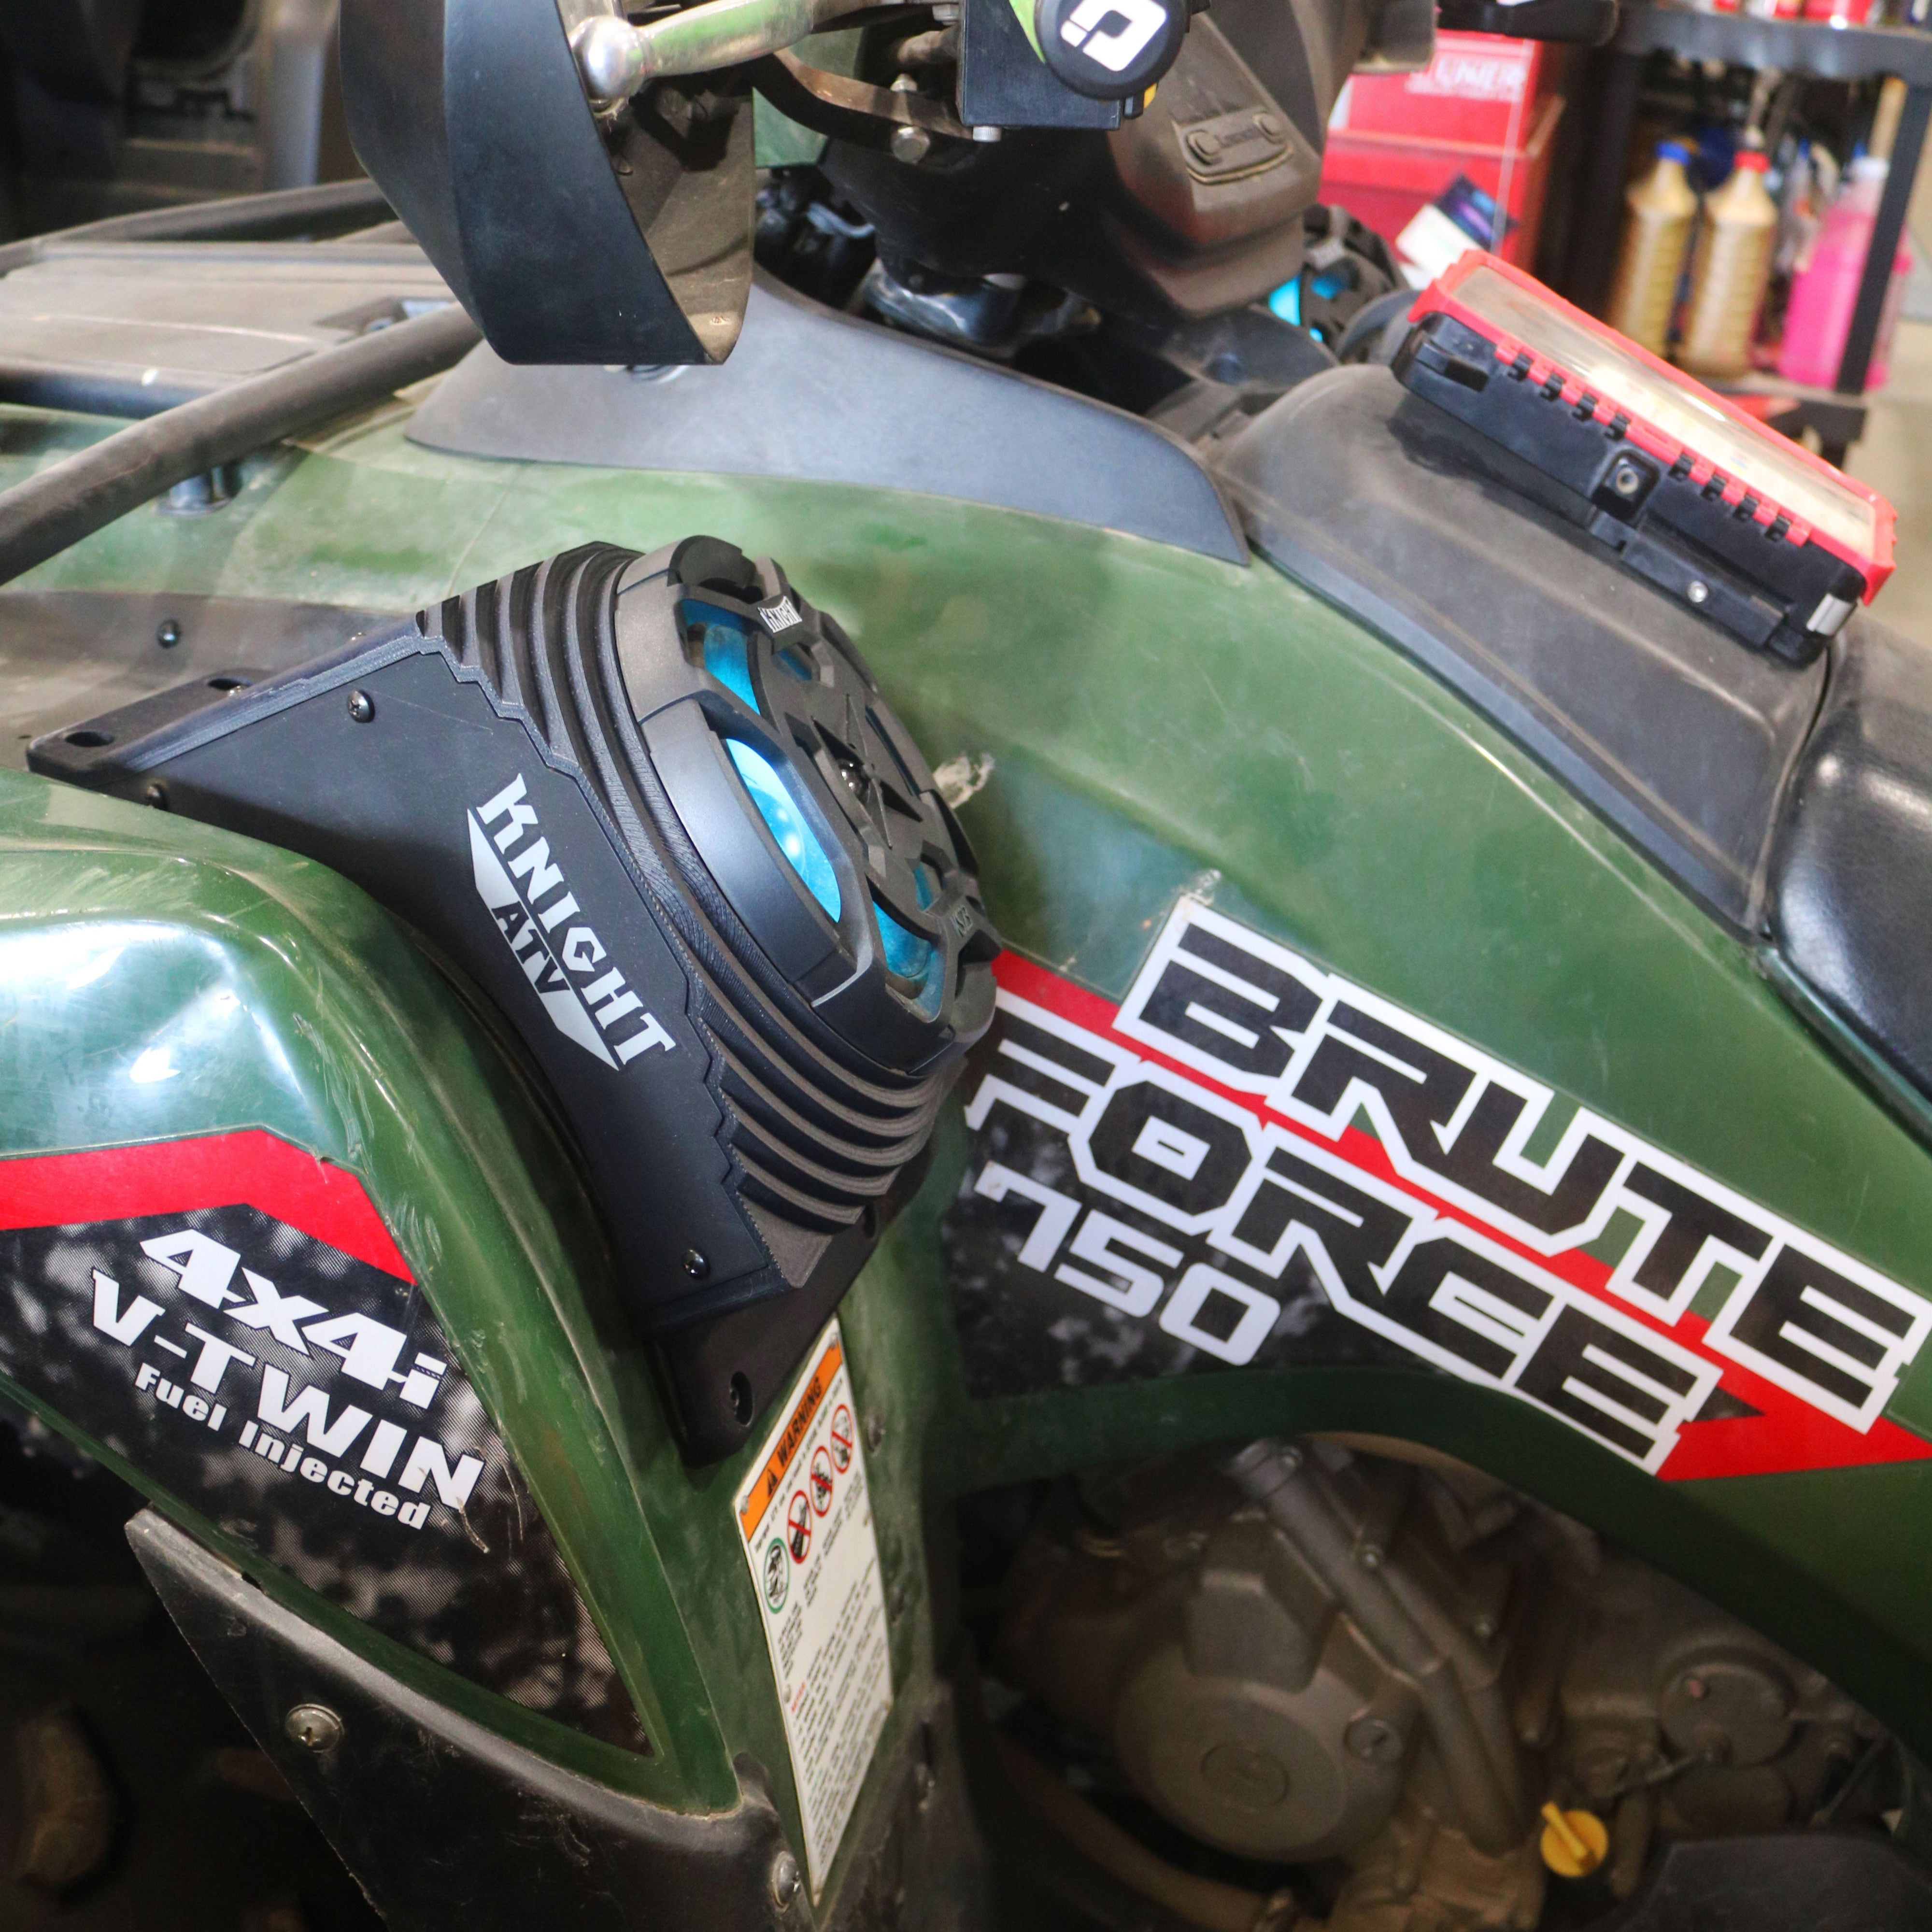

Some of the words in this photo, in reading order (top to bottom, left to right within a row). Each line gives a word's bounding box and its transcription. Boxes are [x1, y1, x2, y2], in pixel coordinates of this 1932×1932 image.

[757, 596, 803, 633] KNIGHT
[476, 772, 676, 1065] KNIGHT
[493, 900, 572, 998] ATV
[964, 987, 1724, 1477] FORCE
[976, 1159, 1281, 1368] 750
[1112, 894, 1932, 1435] BRUTE
[92, 1268, 484, 1511] V-TWIN
[135, 1362, 227, 1431] Fuel
[238, 1420, 431, 1530] Injected
[777, 1377, 821, 1467] WARNING
